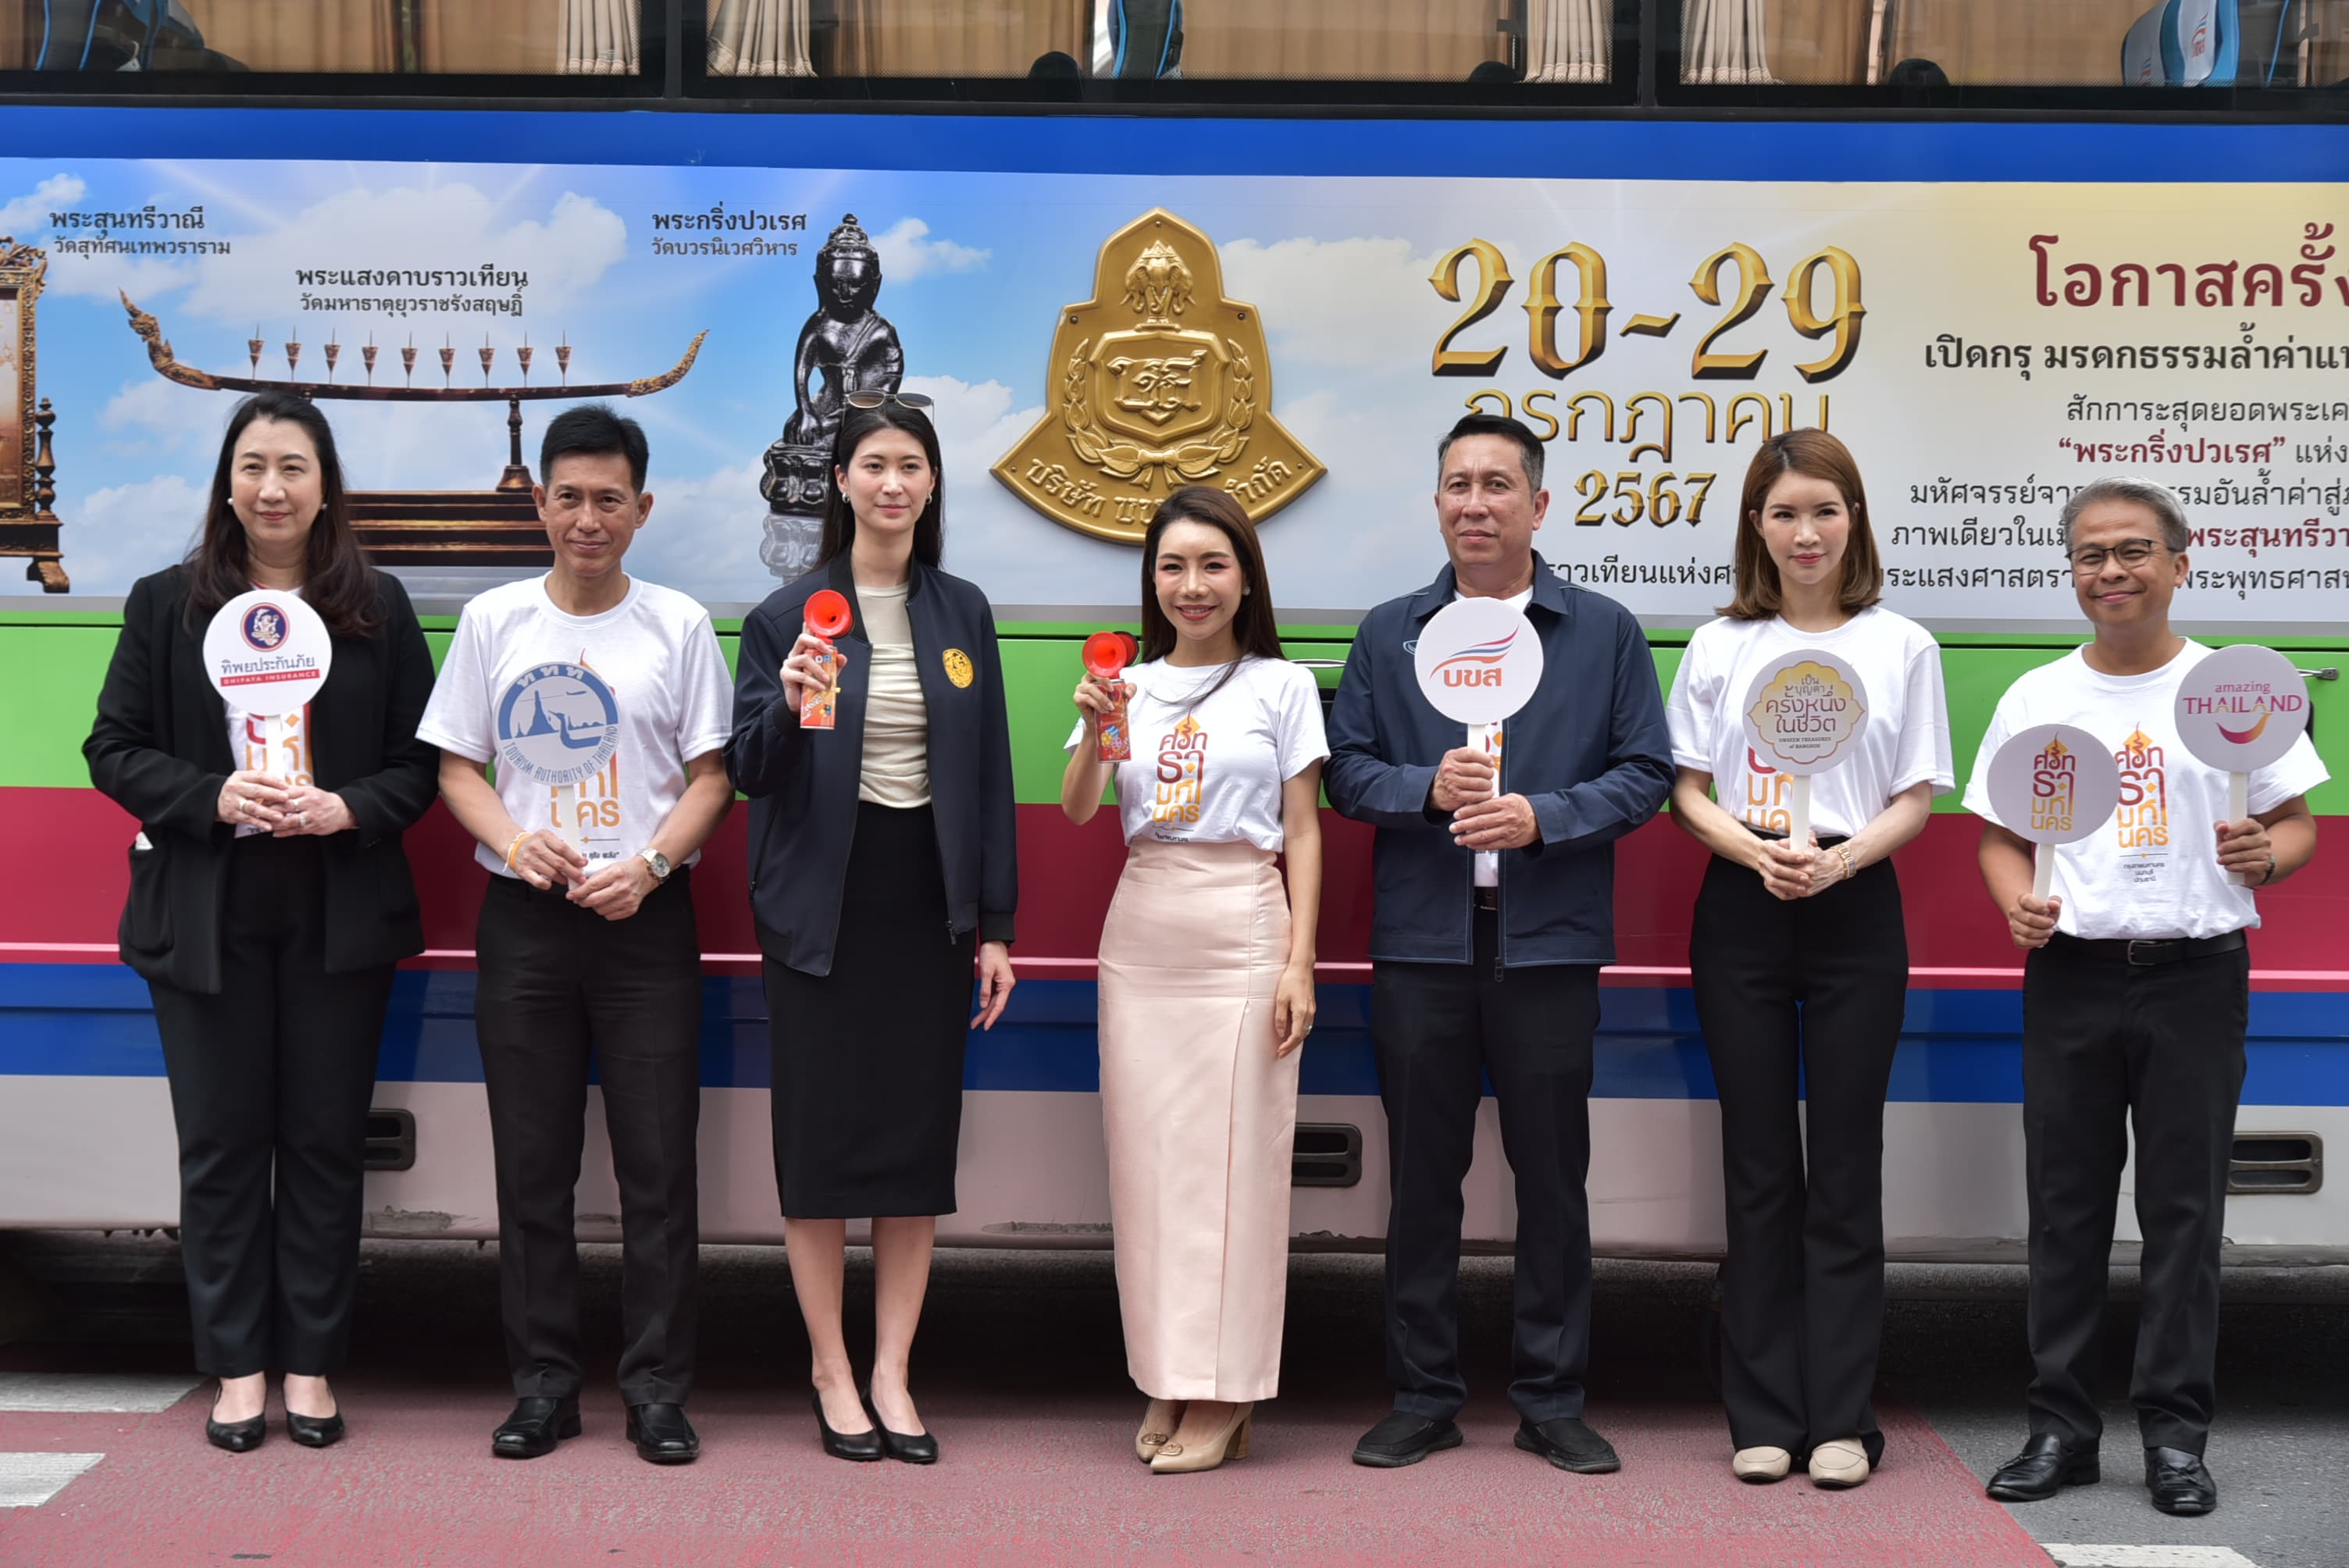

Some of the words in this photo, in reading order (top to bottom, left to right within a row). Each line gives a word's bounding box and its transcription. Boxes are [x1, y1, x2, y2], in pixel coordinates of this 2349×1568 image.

[50, 205, 205, 235] พระสุนทรีวาณี
[652, 201, 807, 230] พระกริ่งปวเรศ
[651, 237, 797, 256] วัดบวรนิเวศวิหาร
[295, 263, 529, 287] พระแสงดาบราวเทียน
[1925, 333, 2032, 381] เปิดกรุ
[2295, 435, 2349, 463] แห่ง
[1025, 458, 1106, 519] บริษัท
[1224, 455, 1293, 503] ำกัด
[1574, 469, 1716, 529] 2567
[1548, 554, 1737, 584] าวเทียนแห่งศ
[1880, 567, 2076, 588] ระแสงศาสตรา
[221, 654, 315, 674] ทิพยประกันภัย
[1444, 668, 1502, 687] บขส
[2215, 681, 2272, 694] amazing
[2183, 694, 2302, 714] THAILAND
[1774, 713, 1836, 733] ในชีวิต
[1152, 804, 1200, 823] นคร
[2030, 815, 2073, 832] นคร
[2118, 826, 2169, 848] นคร
